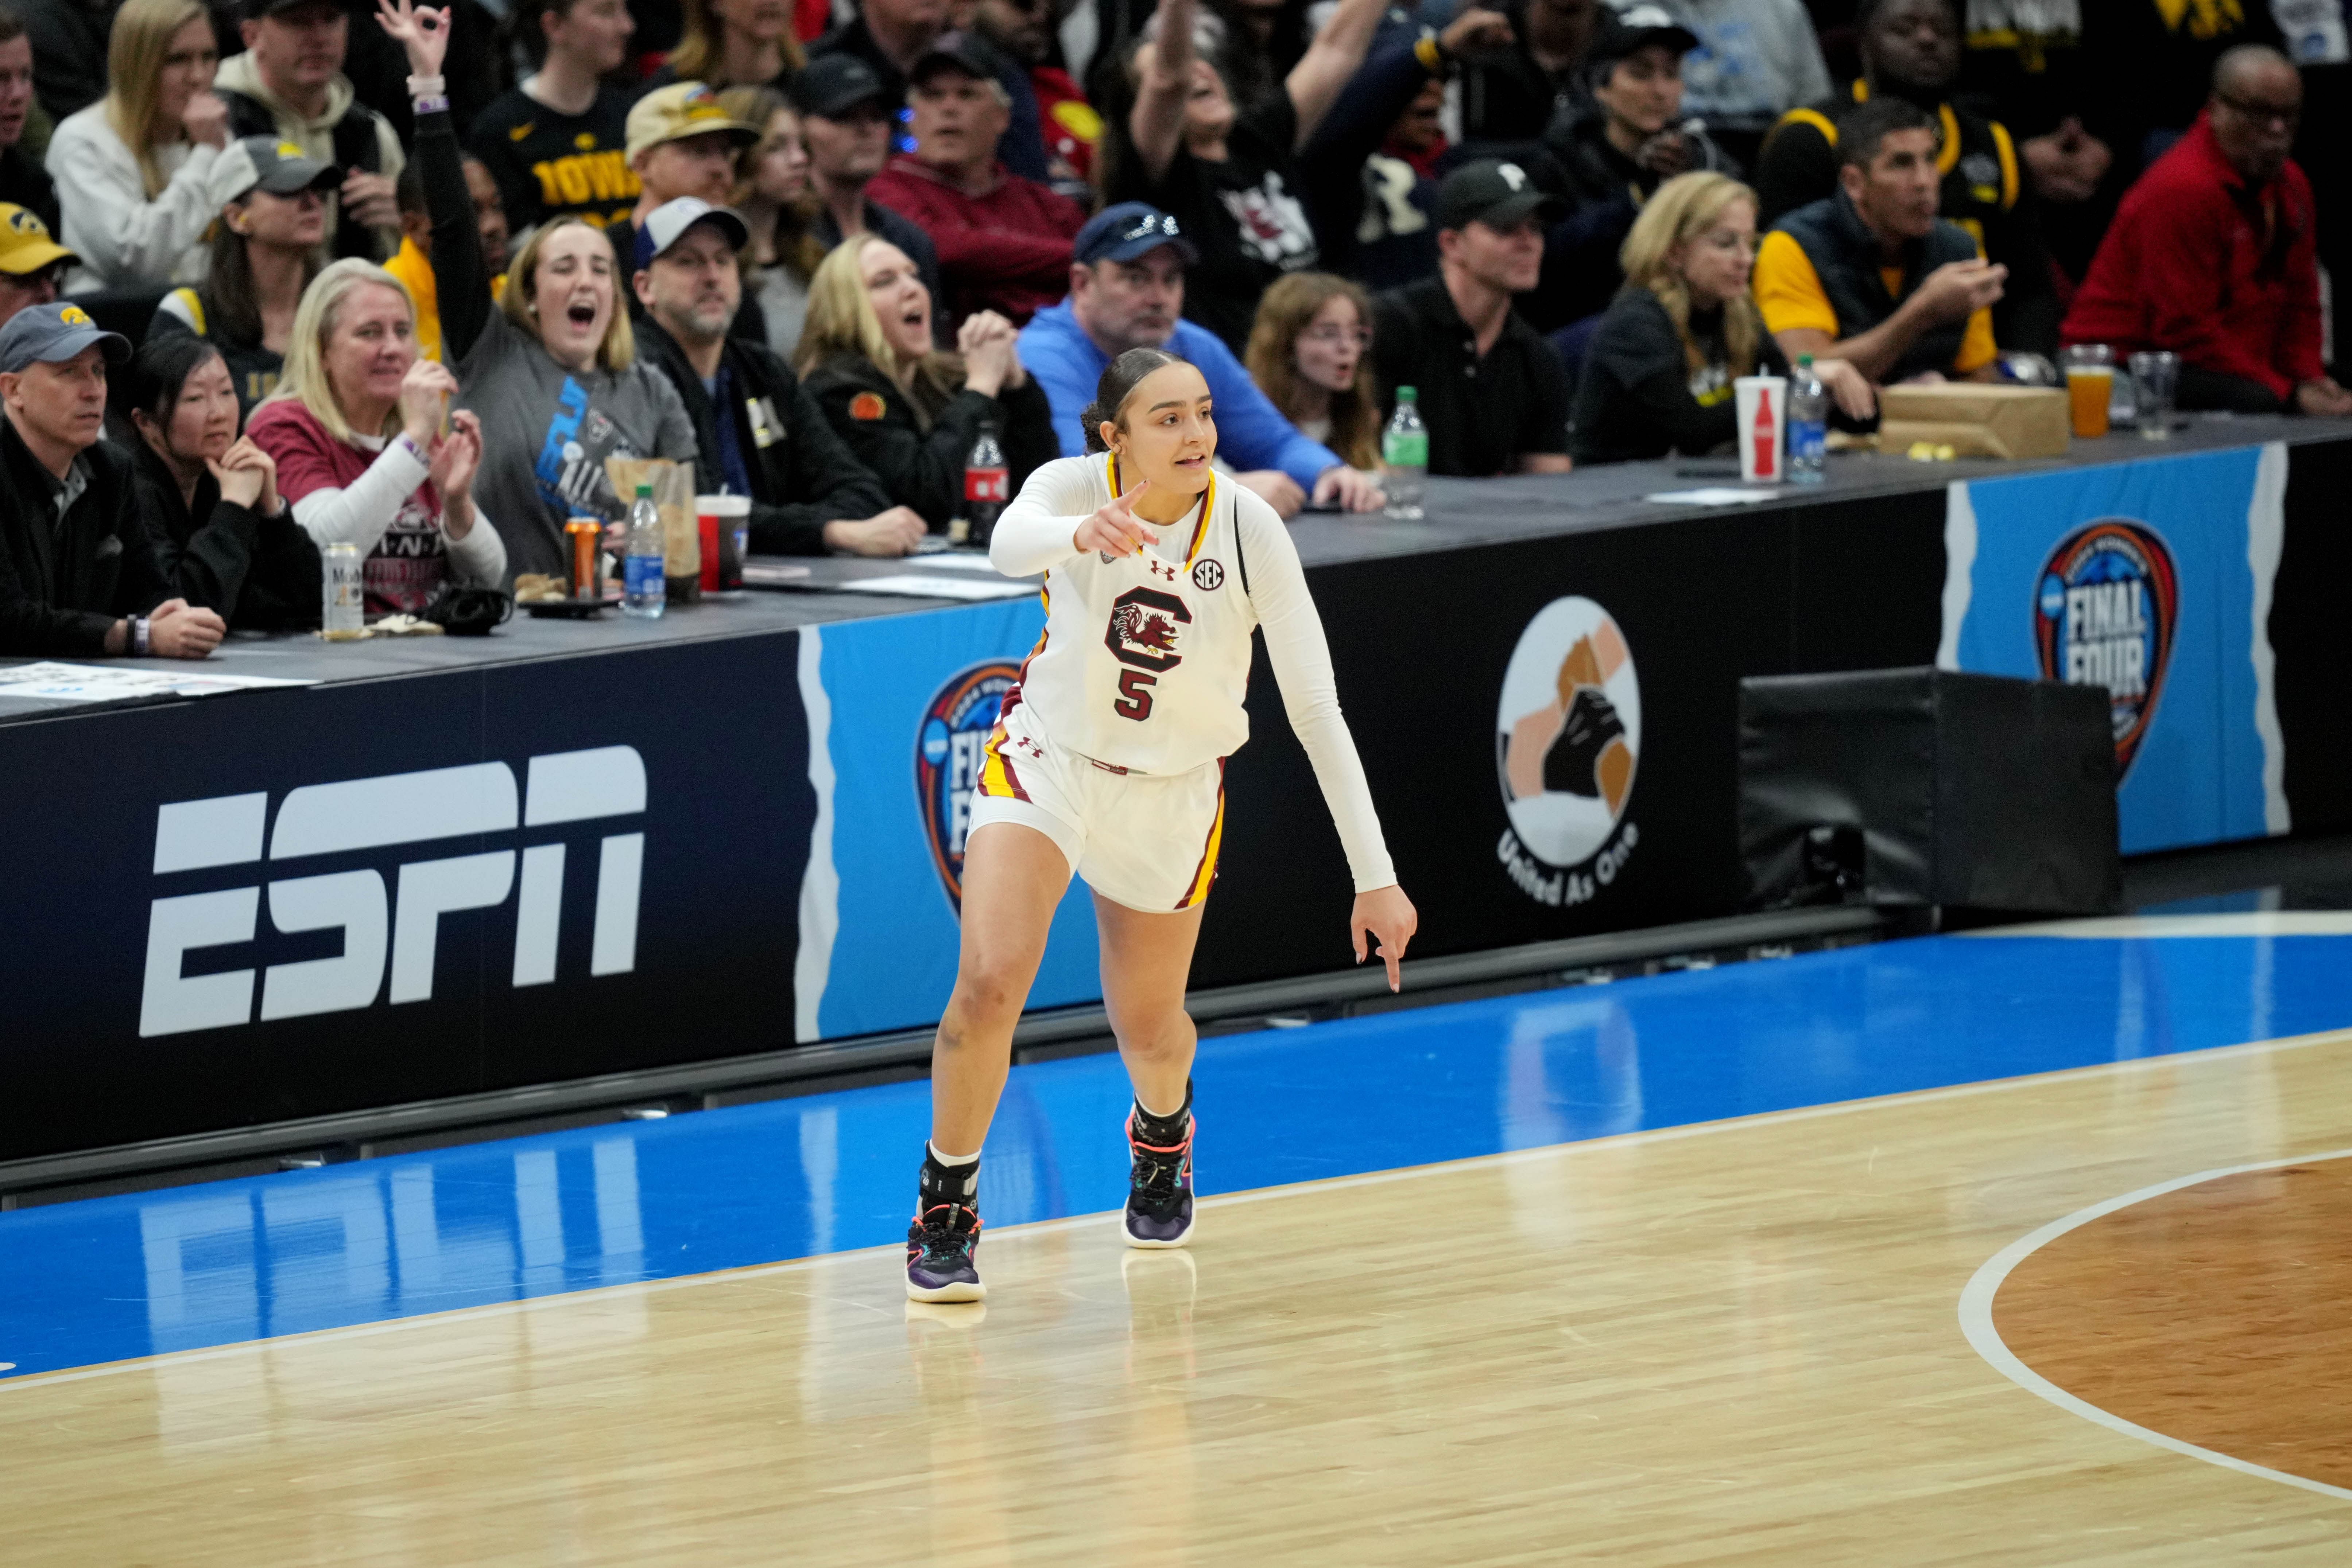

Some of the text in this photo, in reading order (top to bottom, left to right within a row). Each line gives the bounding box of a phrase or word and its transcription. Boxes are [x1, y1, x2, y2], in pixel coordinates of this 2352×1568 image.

[1195, 561, 1222, 589] SEC
[2067, 581, 2145, 640] FINAL
[1114, 668, 1158, 722] 5
[2068, 637, 2146, 696] FOUR
[139, 745, 647, 1038] ESPN
[1497, 822, 1639, 907] United As One
[922, 1177, 929, 1186] 60
